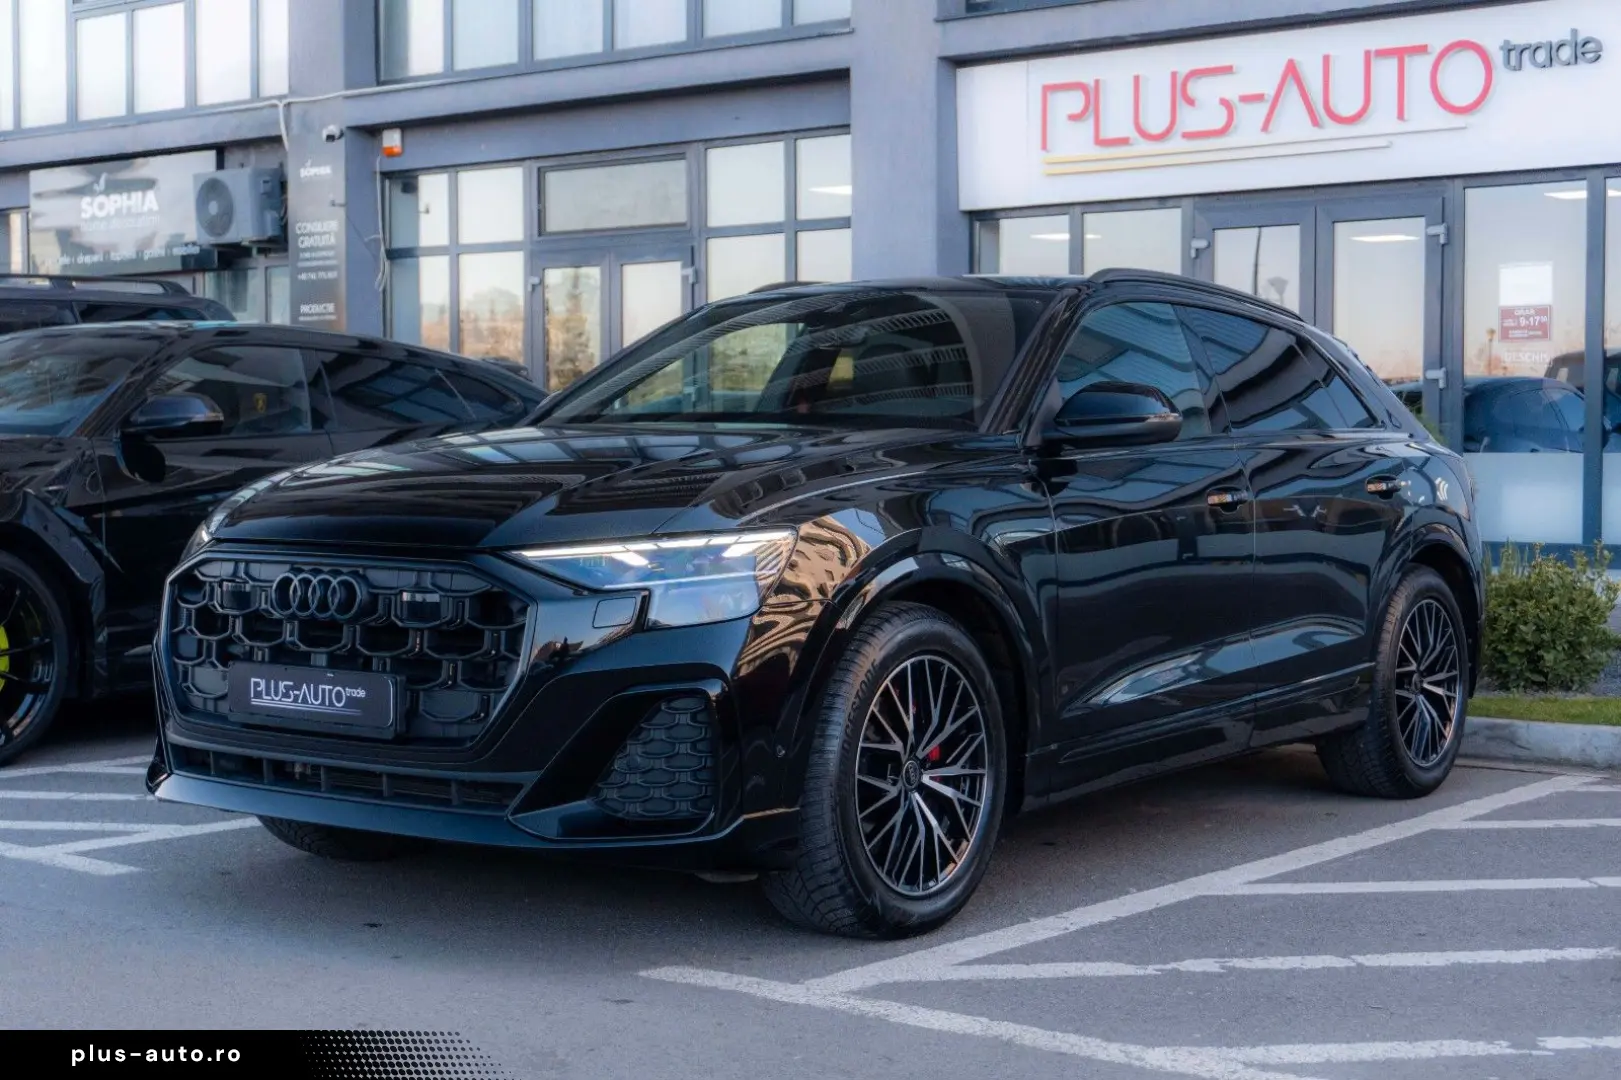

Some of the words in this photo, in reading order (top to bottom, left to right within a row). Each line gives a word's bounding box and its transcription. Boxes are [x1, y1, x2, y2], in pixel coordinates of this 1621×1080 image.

[1041, 39, 1494, 152] PLUS-AUTO
[1500, 29, 1603, 71] trade
[80, 189, 159, 219] SOPHIA
[251, 677, 346, 707] PLUS-AUTO
[345, 687, 366, 698] trade
